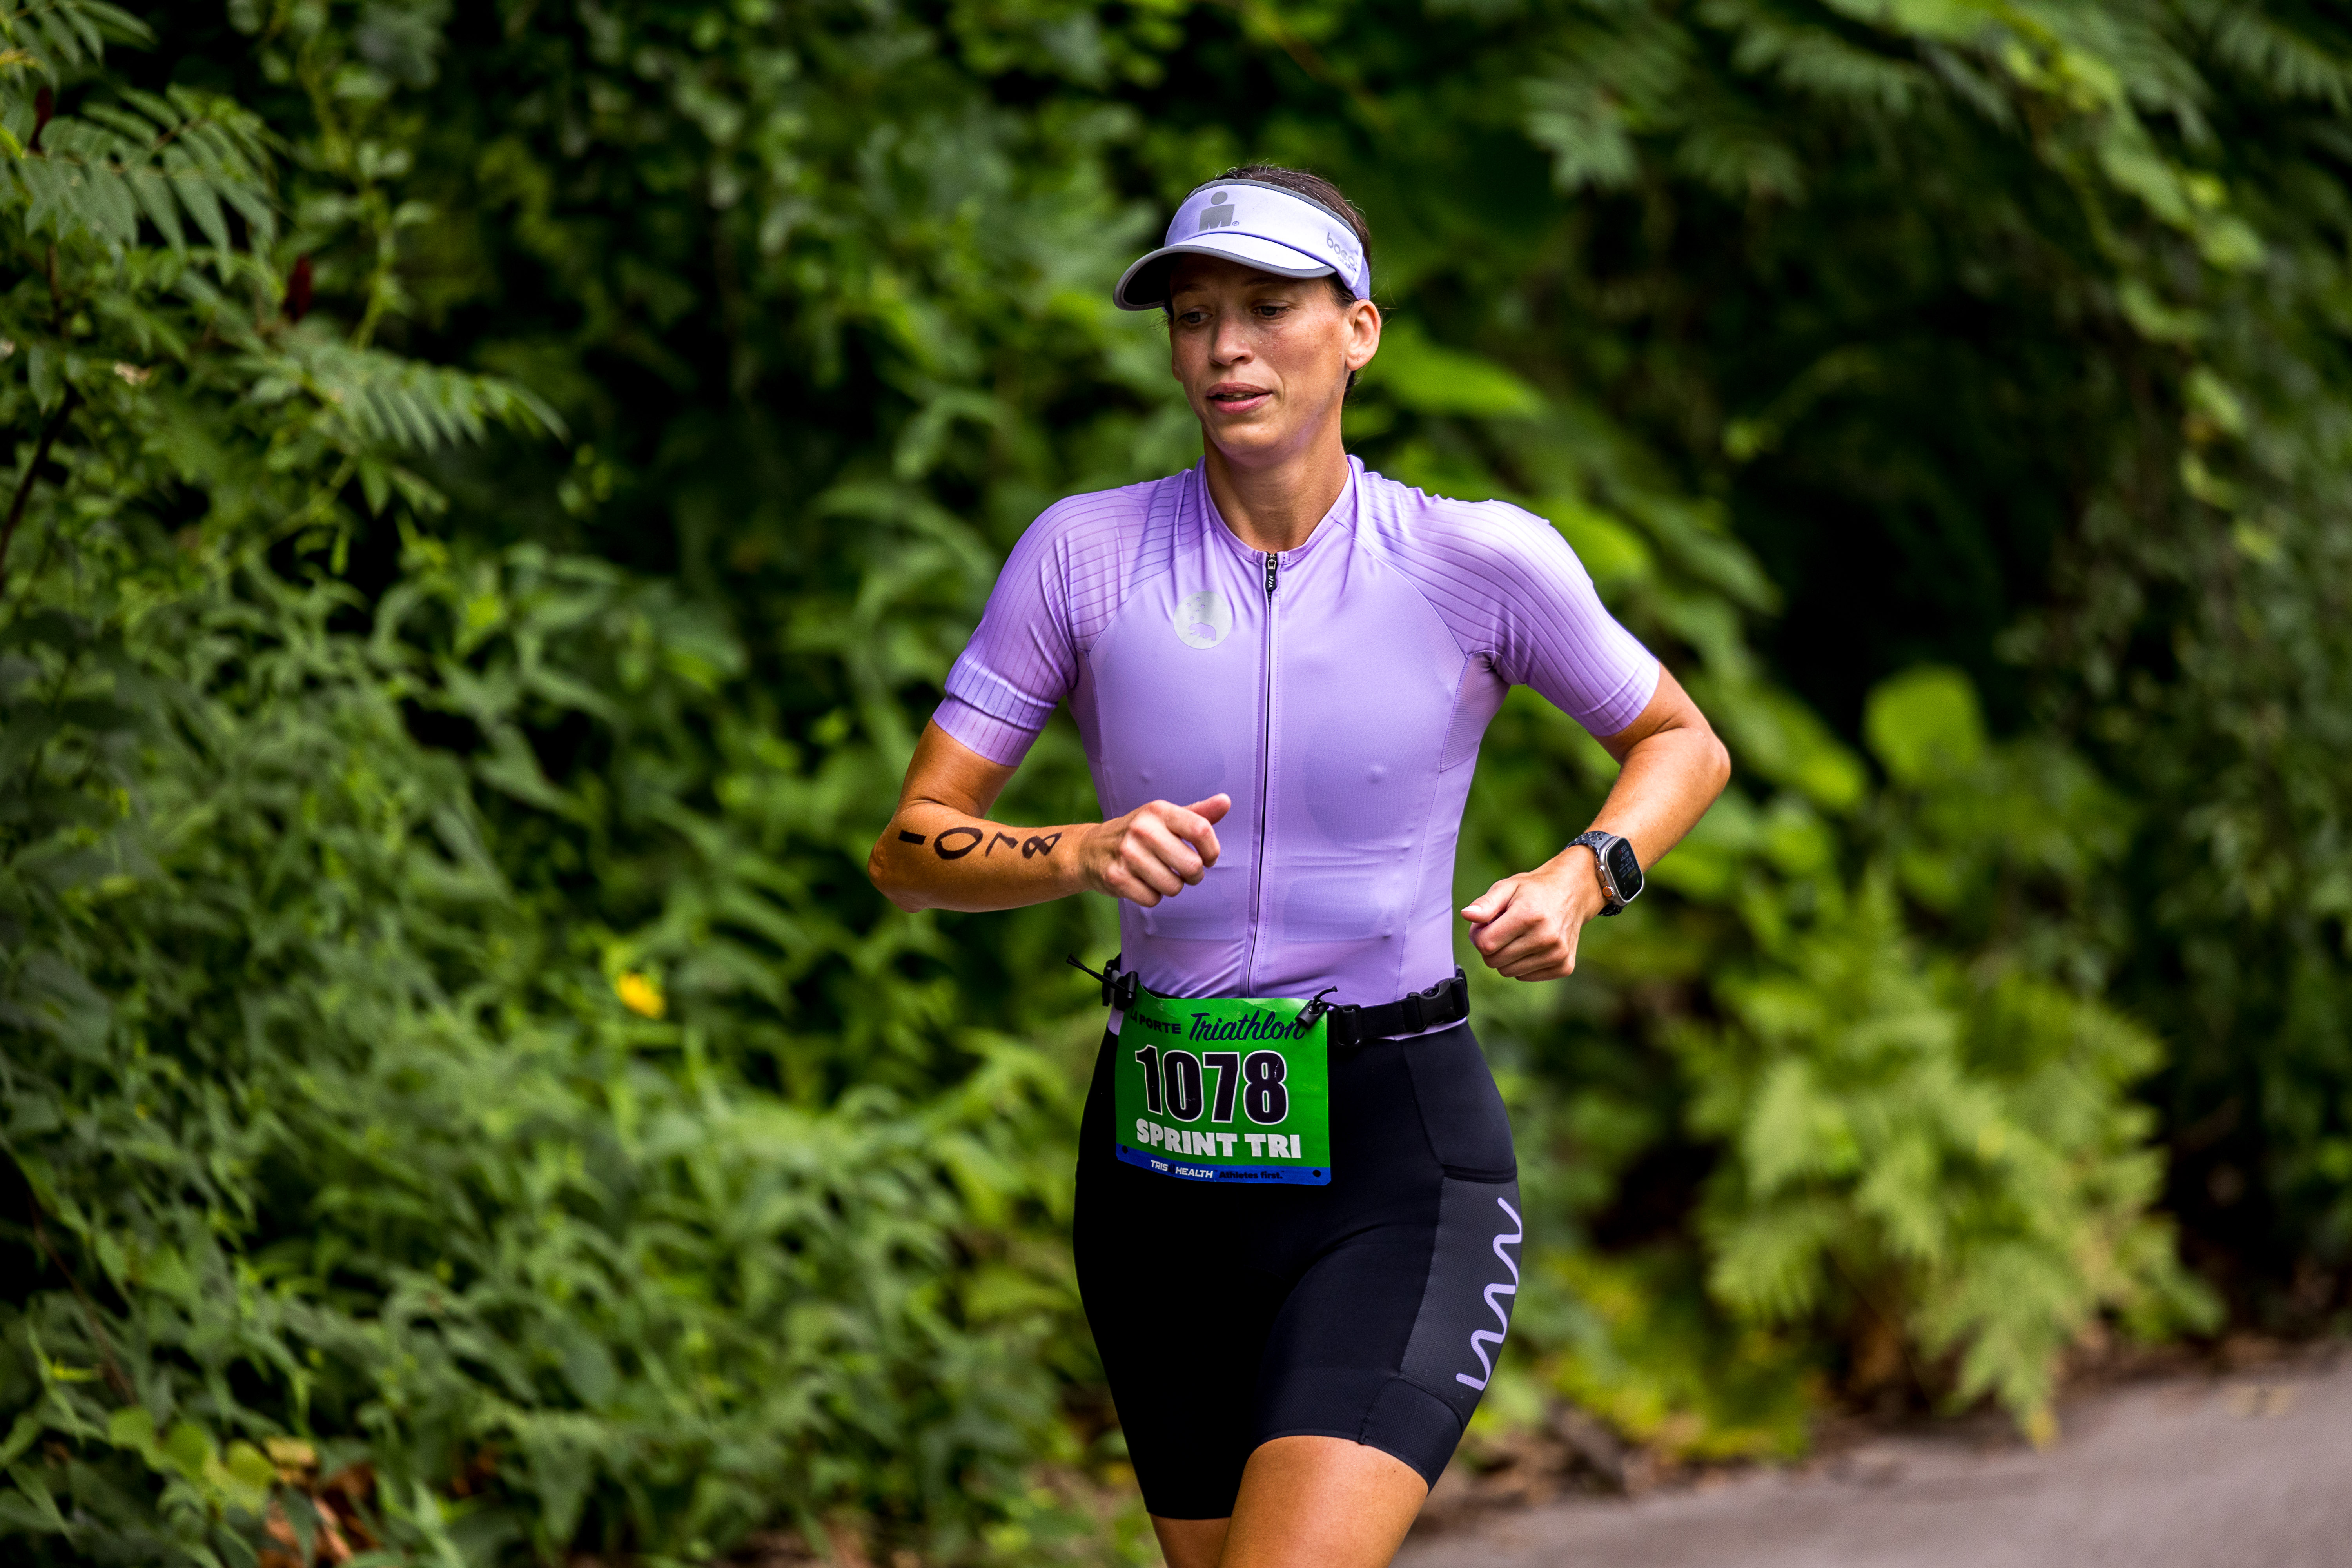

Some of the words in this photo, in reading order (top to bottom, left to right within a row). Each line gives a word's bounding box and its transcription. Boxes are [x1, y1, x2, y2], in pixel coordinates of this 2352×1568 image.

[1327, 232, 1355, 267] boco
[898, 826, 1062, 860] 1078
[1130, 1008, 1138, 1023] LA
[1139, 1014, 1181, 1034] PORTE
[1189, 1009, 1305, 1042] Triathlon
[1135, 1044, 1289, 1125] 1078
[1136, 1118, 1238, 1157] SPRINT
[1244, 1133, 1301, 1158] TRI
